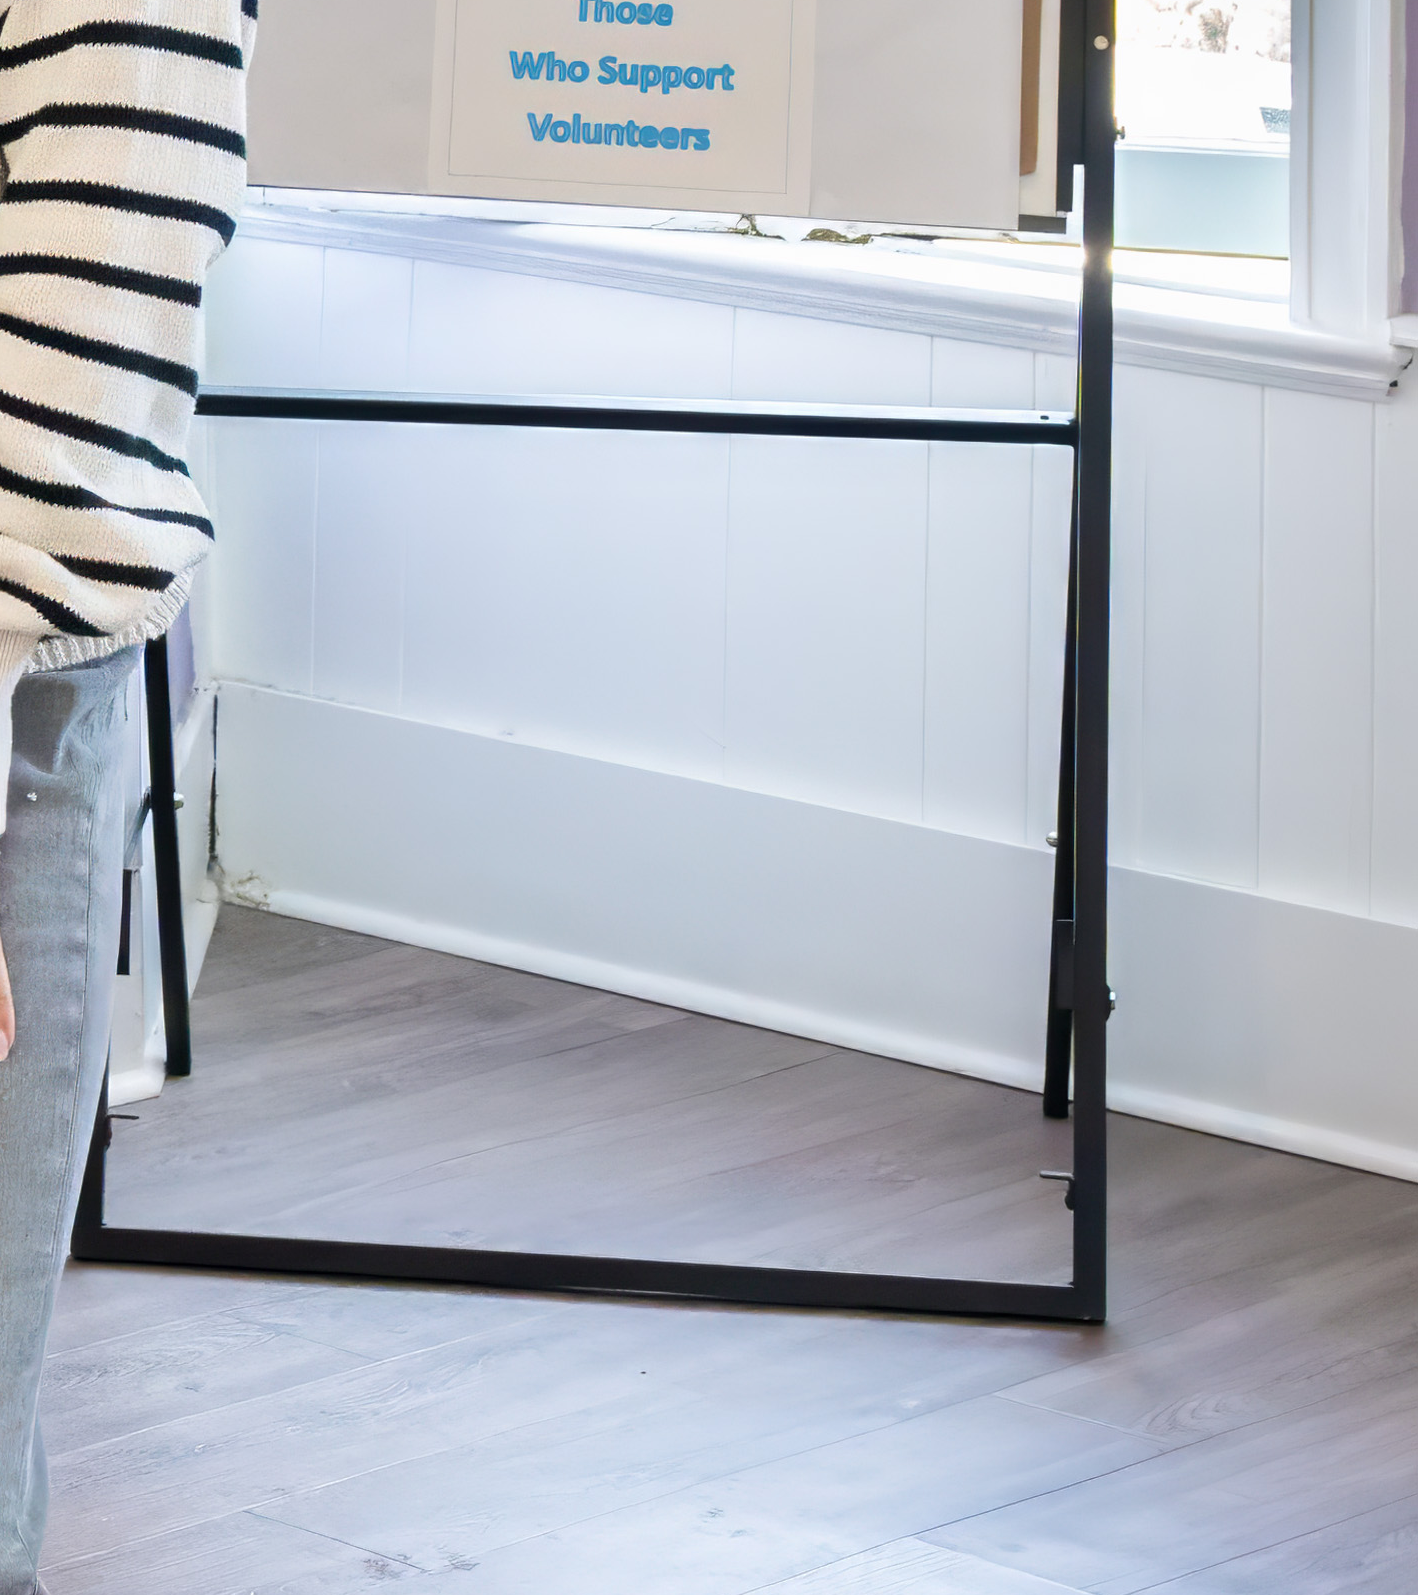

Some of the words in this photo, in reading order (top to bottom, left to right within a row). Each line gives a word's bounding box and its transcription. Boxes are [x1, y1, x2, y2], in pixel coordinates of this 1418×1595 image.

[509, 51, 590, 84] Who
[598, 57, 735, 94] Support
[527, 112, 710, 151] Volunteers
